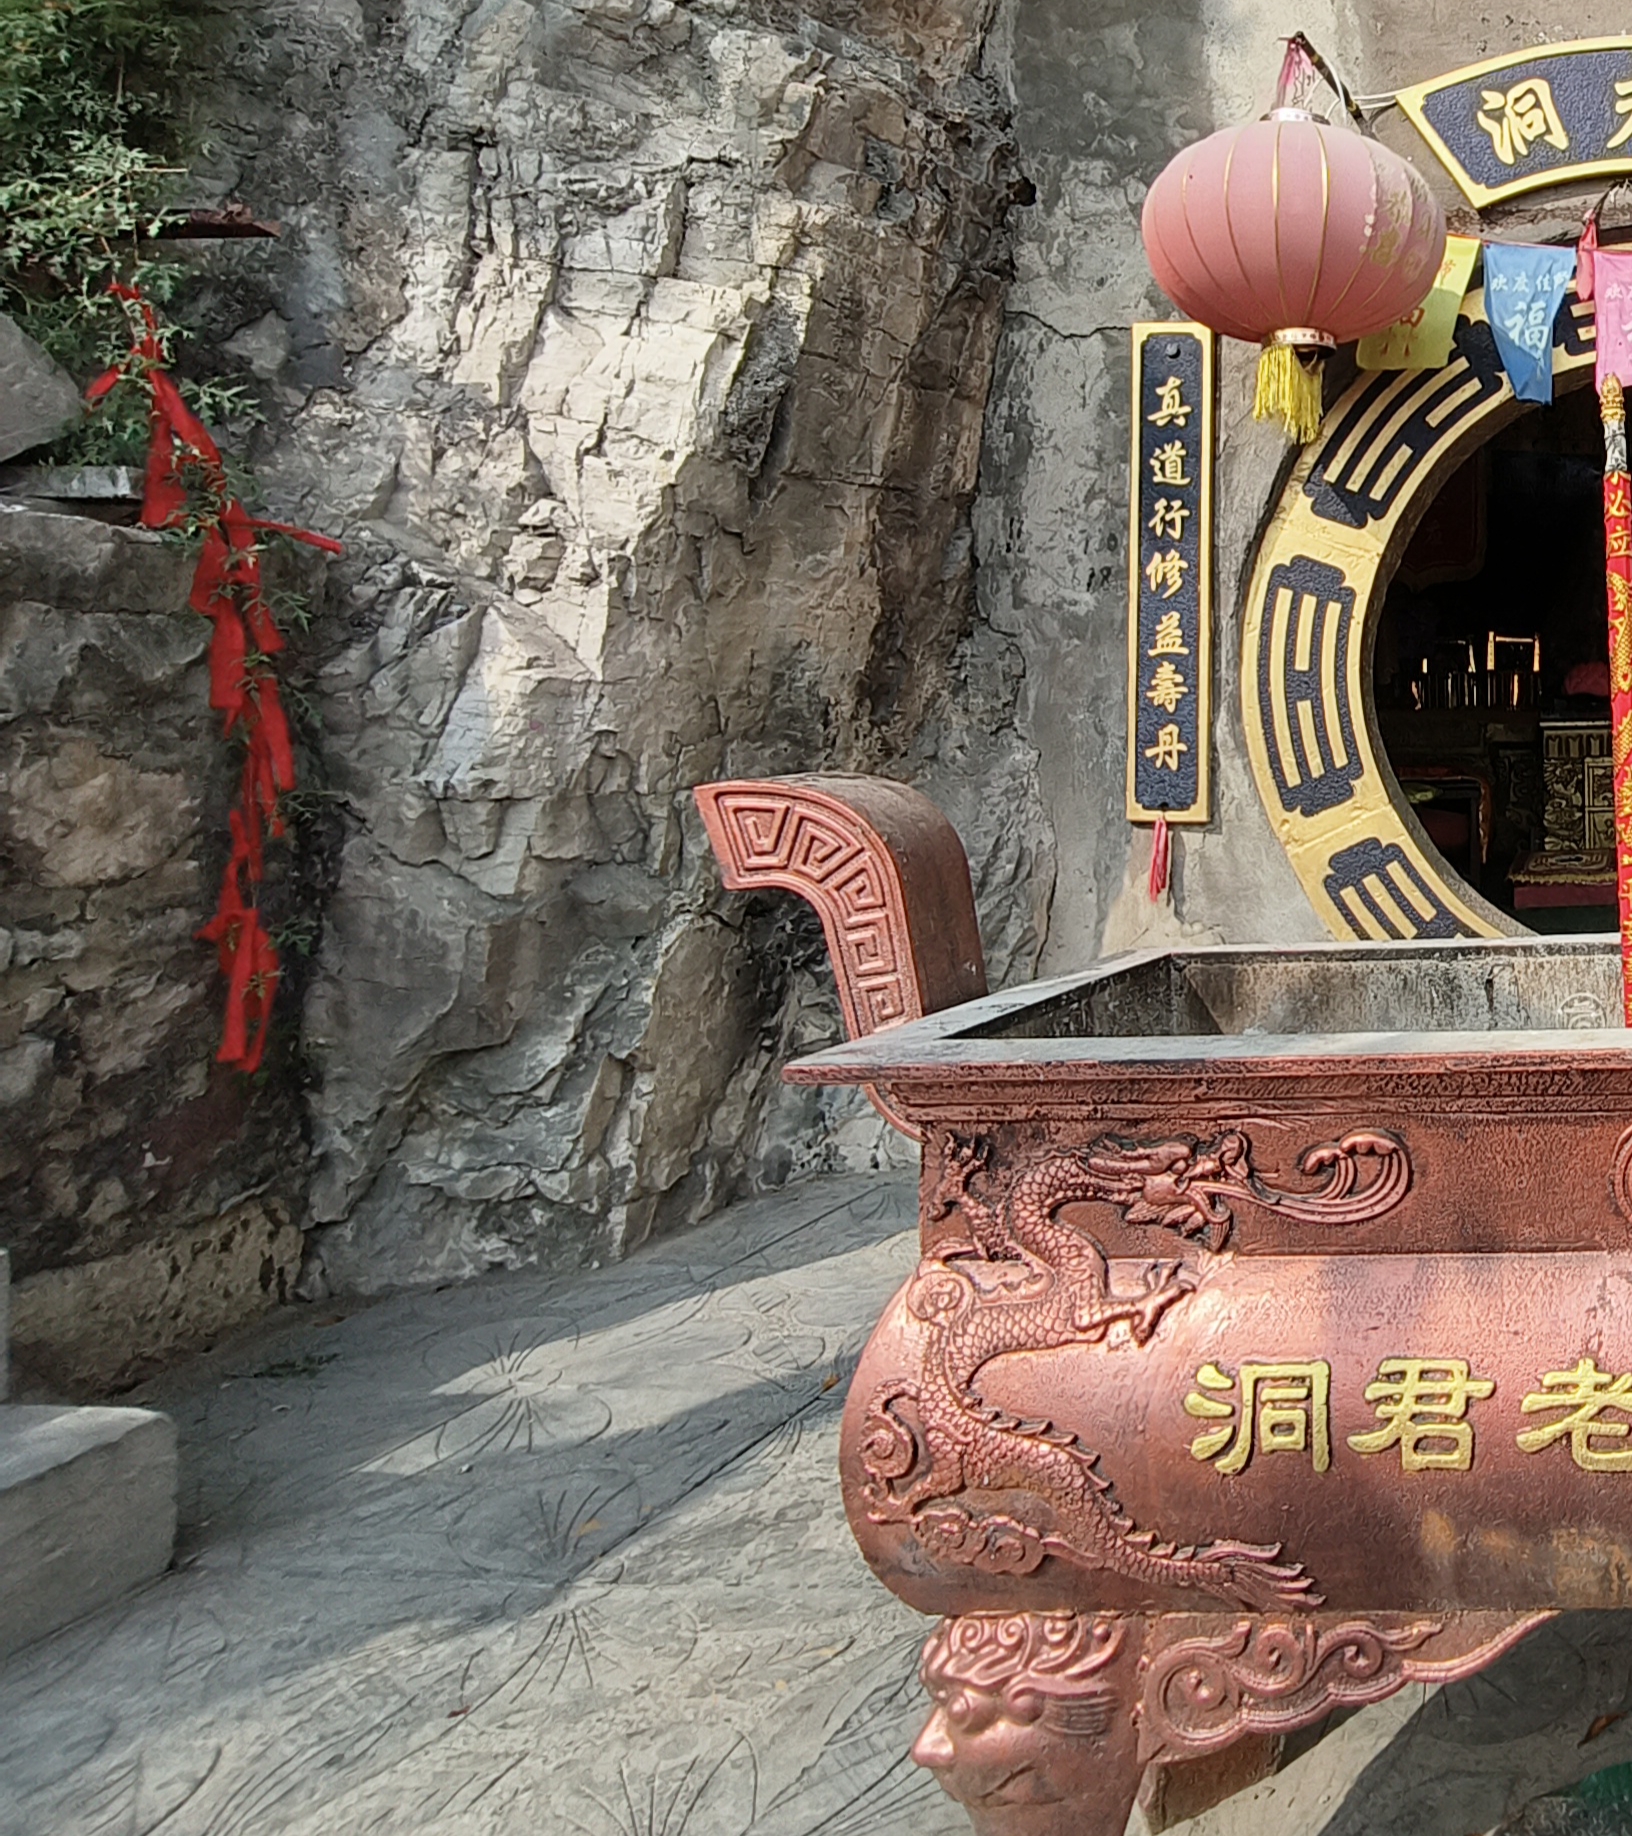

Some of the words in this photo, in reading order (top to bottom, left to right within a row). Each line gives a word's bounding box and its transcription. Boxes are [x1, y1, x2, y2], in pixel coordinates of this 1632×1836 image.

[1504, 301, 1549, 351] 福
[1144, 375, 1193, 773] 真道行修益壽丹
